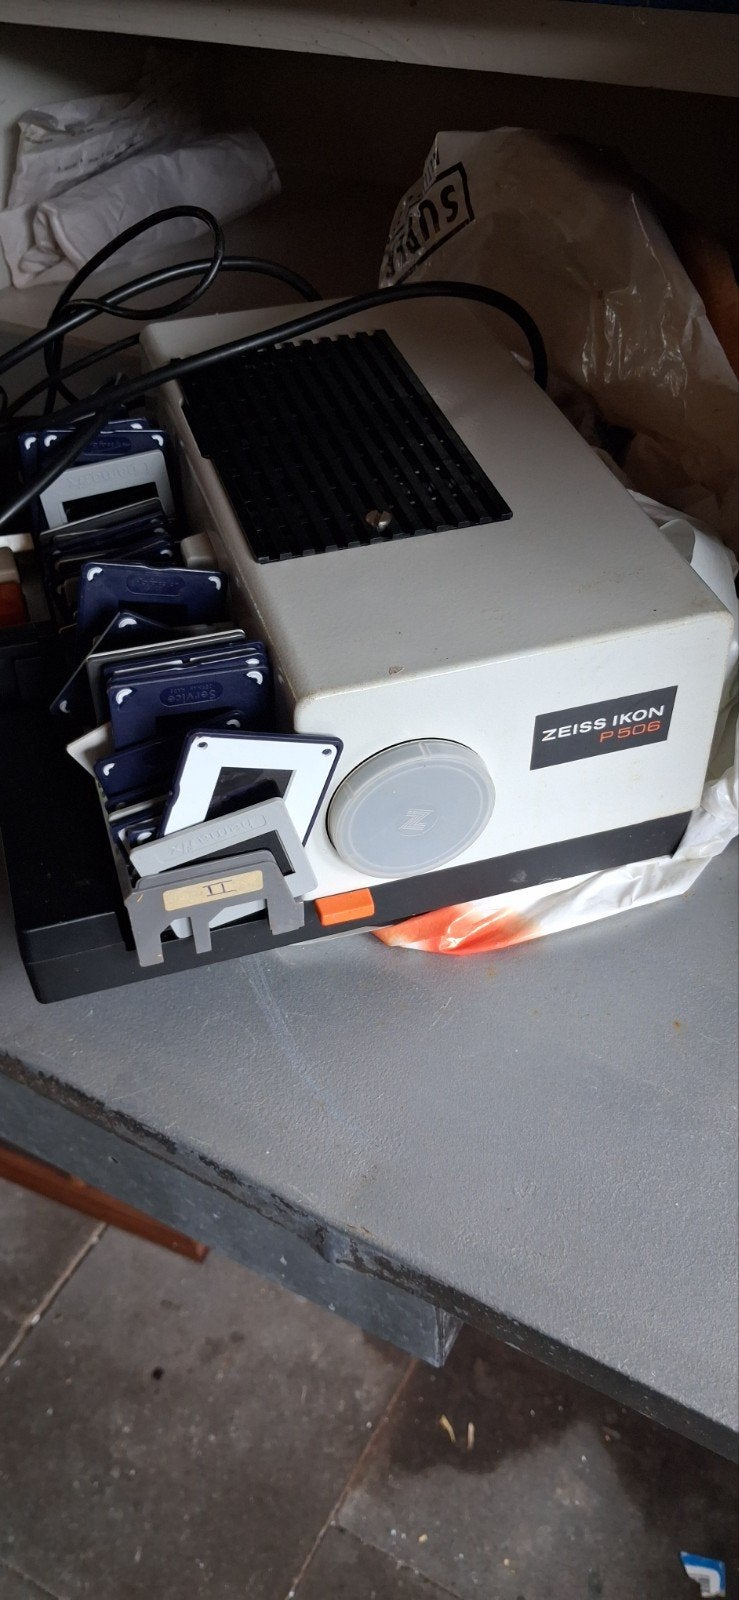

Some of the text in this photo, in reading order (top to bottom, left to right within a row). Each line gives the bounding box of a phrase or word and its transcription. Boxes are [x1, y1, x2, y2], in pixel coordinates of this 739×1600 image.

[167, 689, 216, 703] Service
[541, 704, 665, 742] ZEISS IKON
[599, 719, 661, 743] P 506
